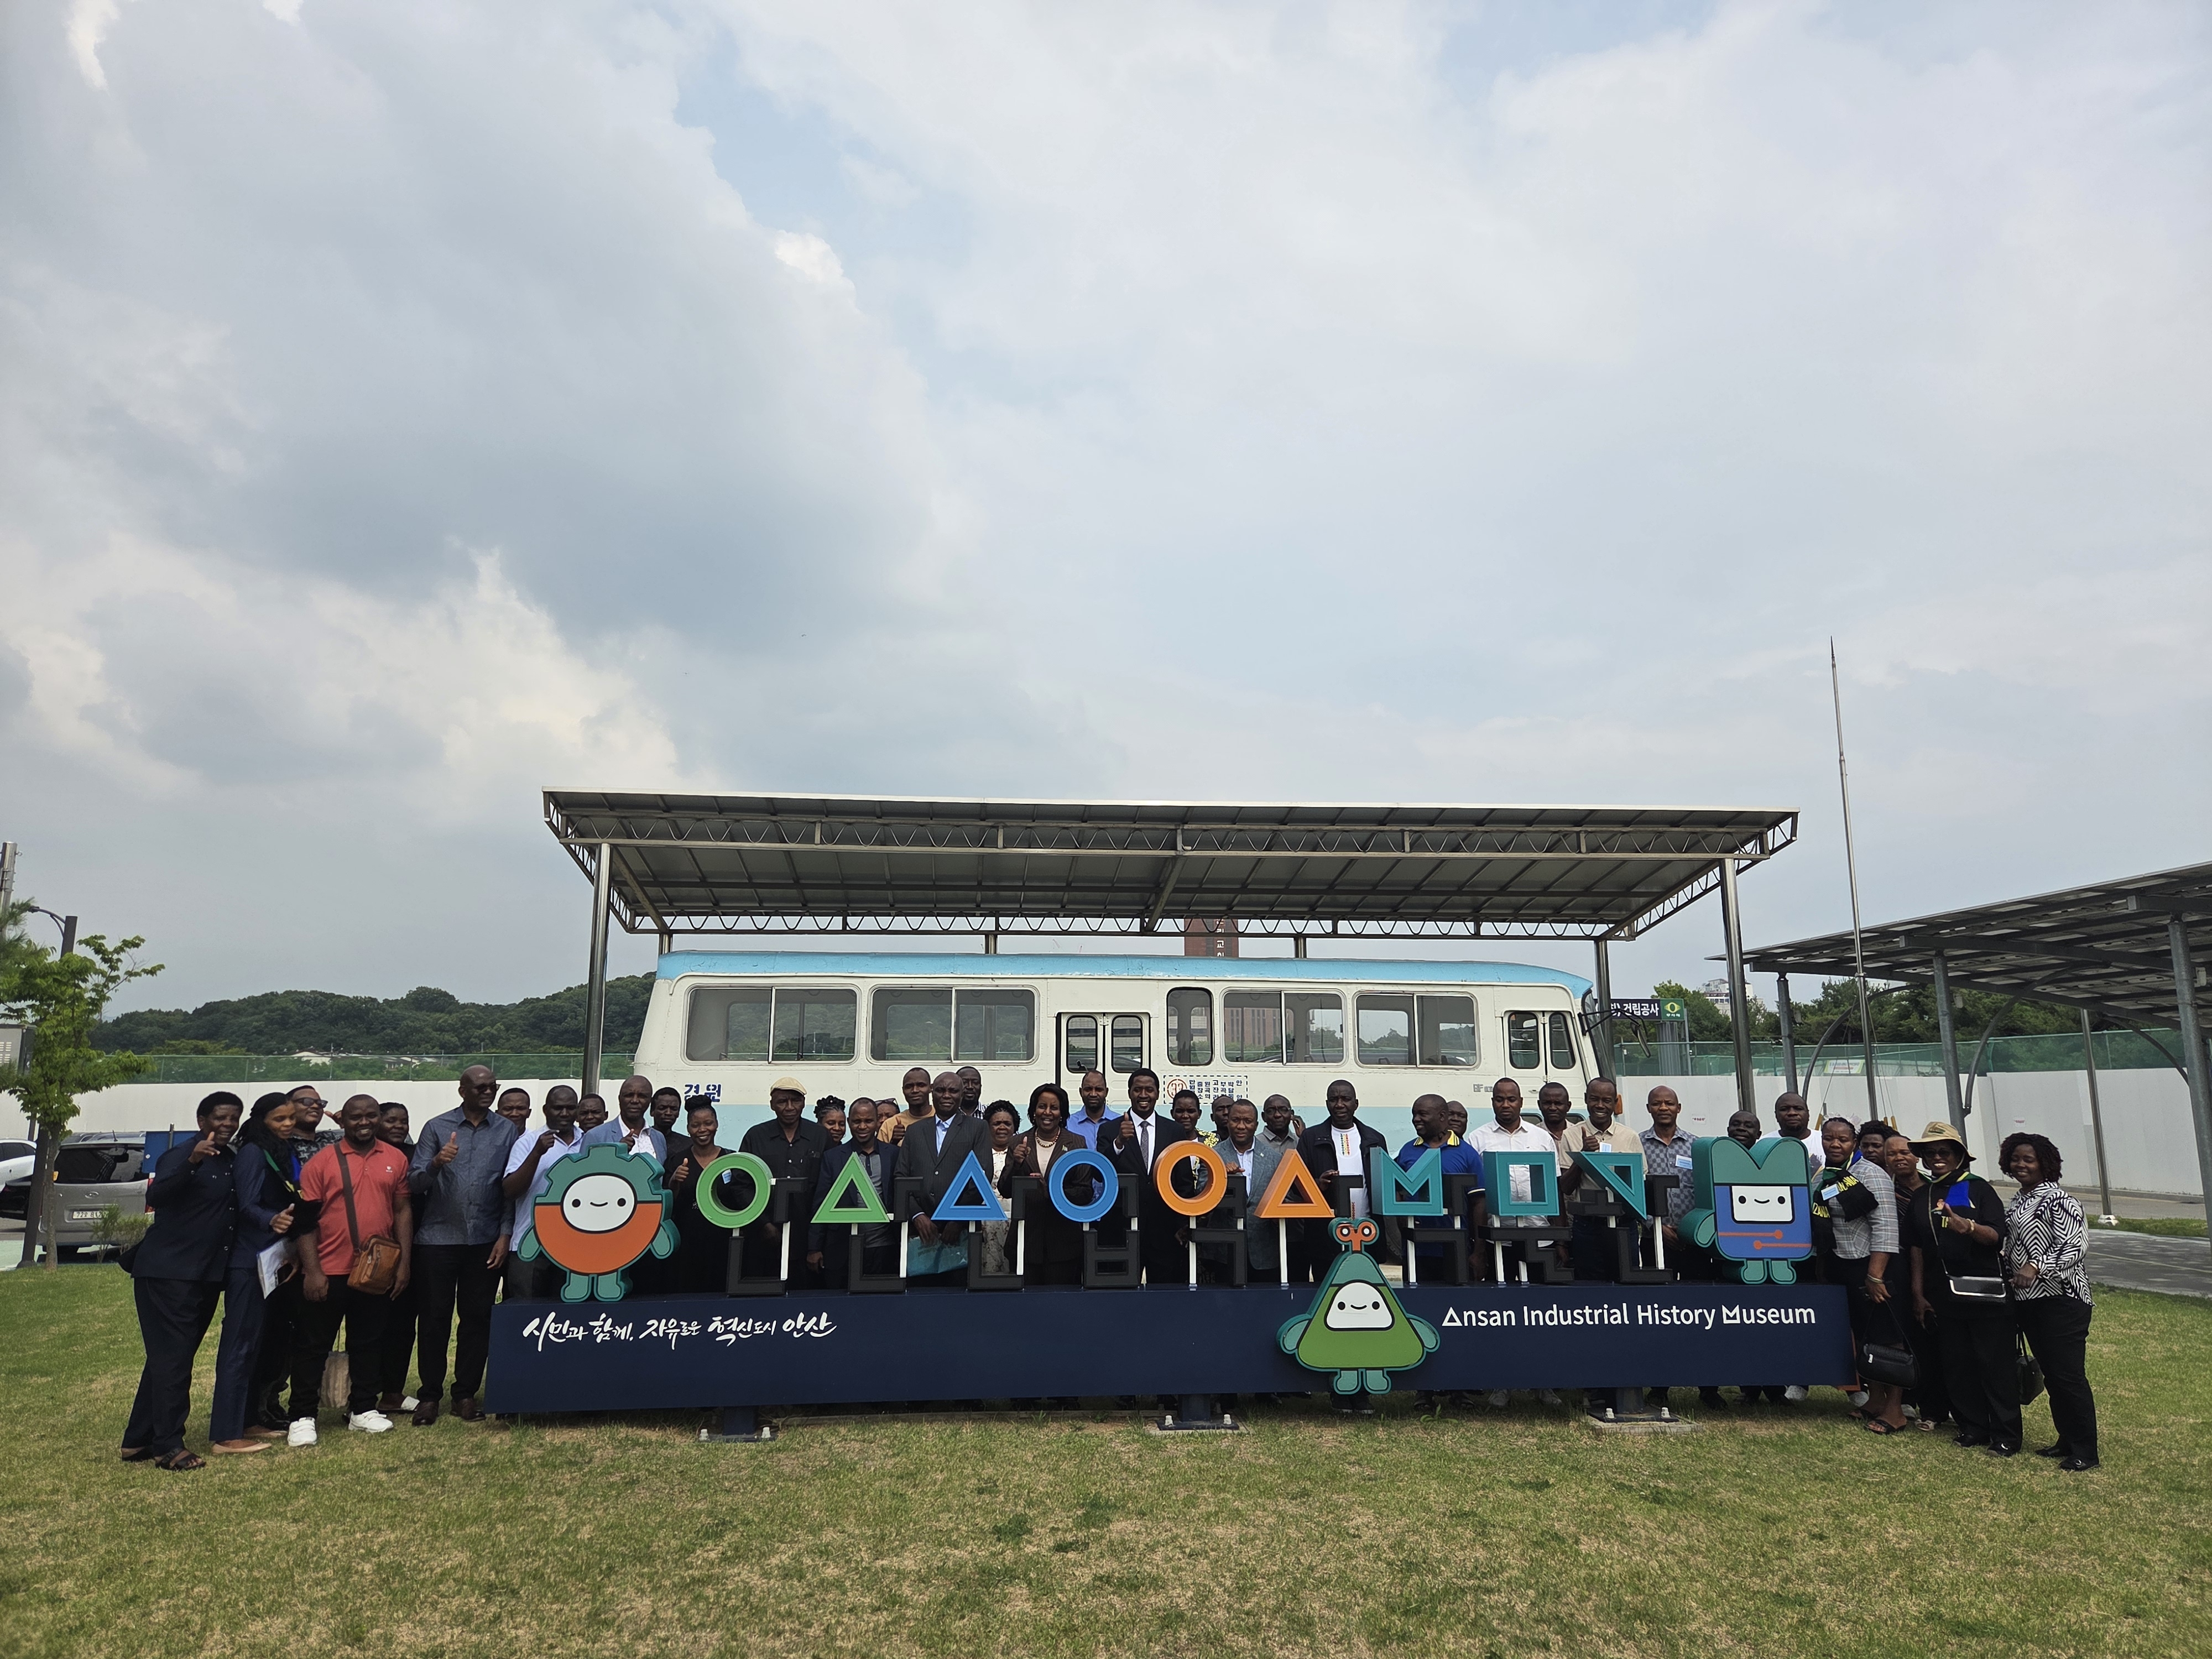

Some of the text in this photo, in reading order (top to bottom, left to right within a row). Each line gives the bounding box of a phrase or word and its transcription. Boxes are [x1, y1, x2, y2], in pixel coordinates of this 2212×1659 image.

[1623, 1003, 1660, 1017] 건립공사
[1441, 1303, 1816, 1330] Ansan Industrial History Museum
[523, 1312, 837, 1352] 시민과 함께, 자유로운 혁신도시 안산
